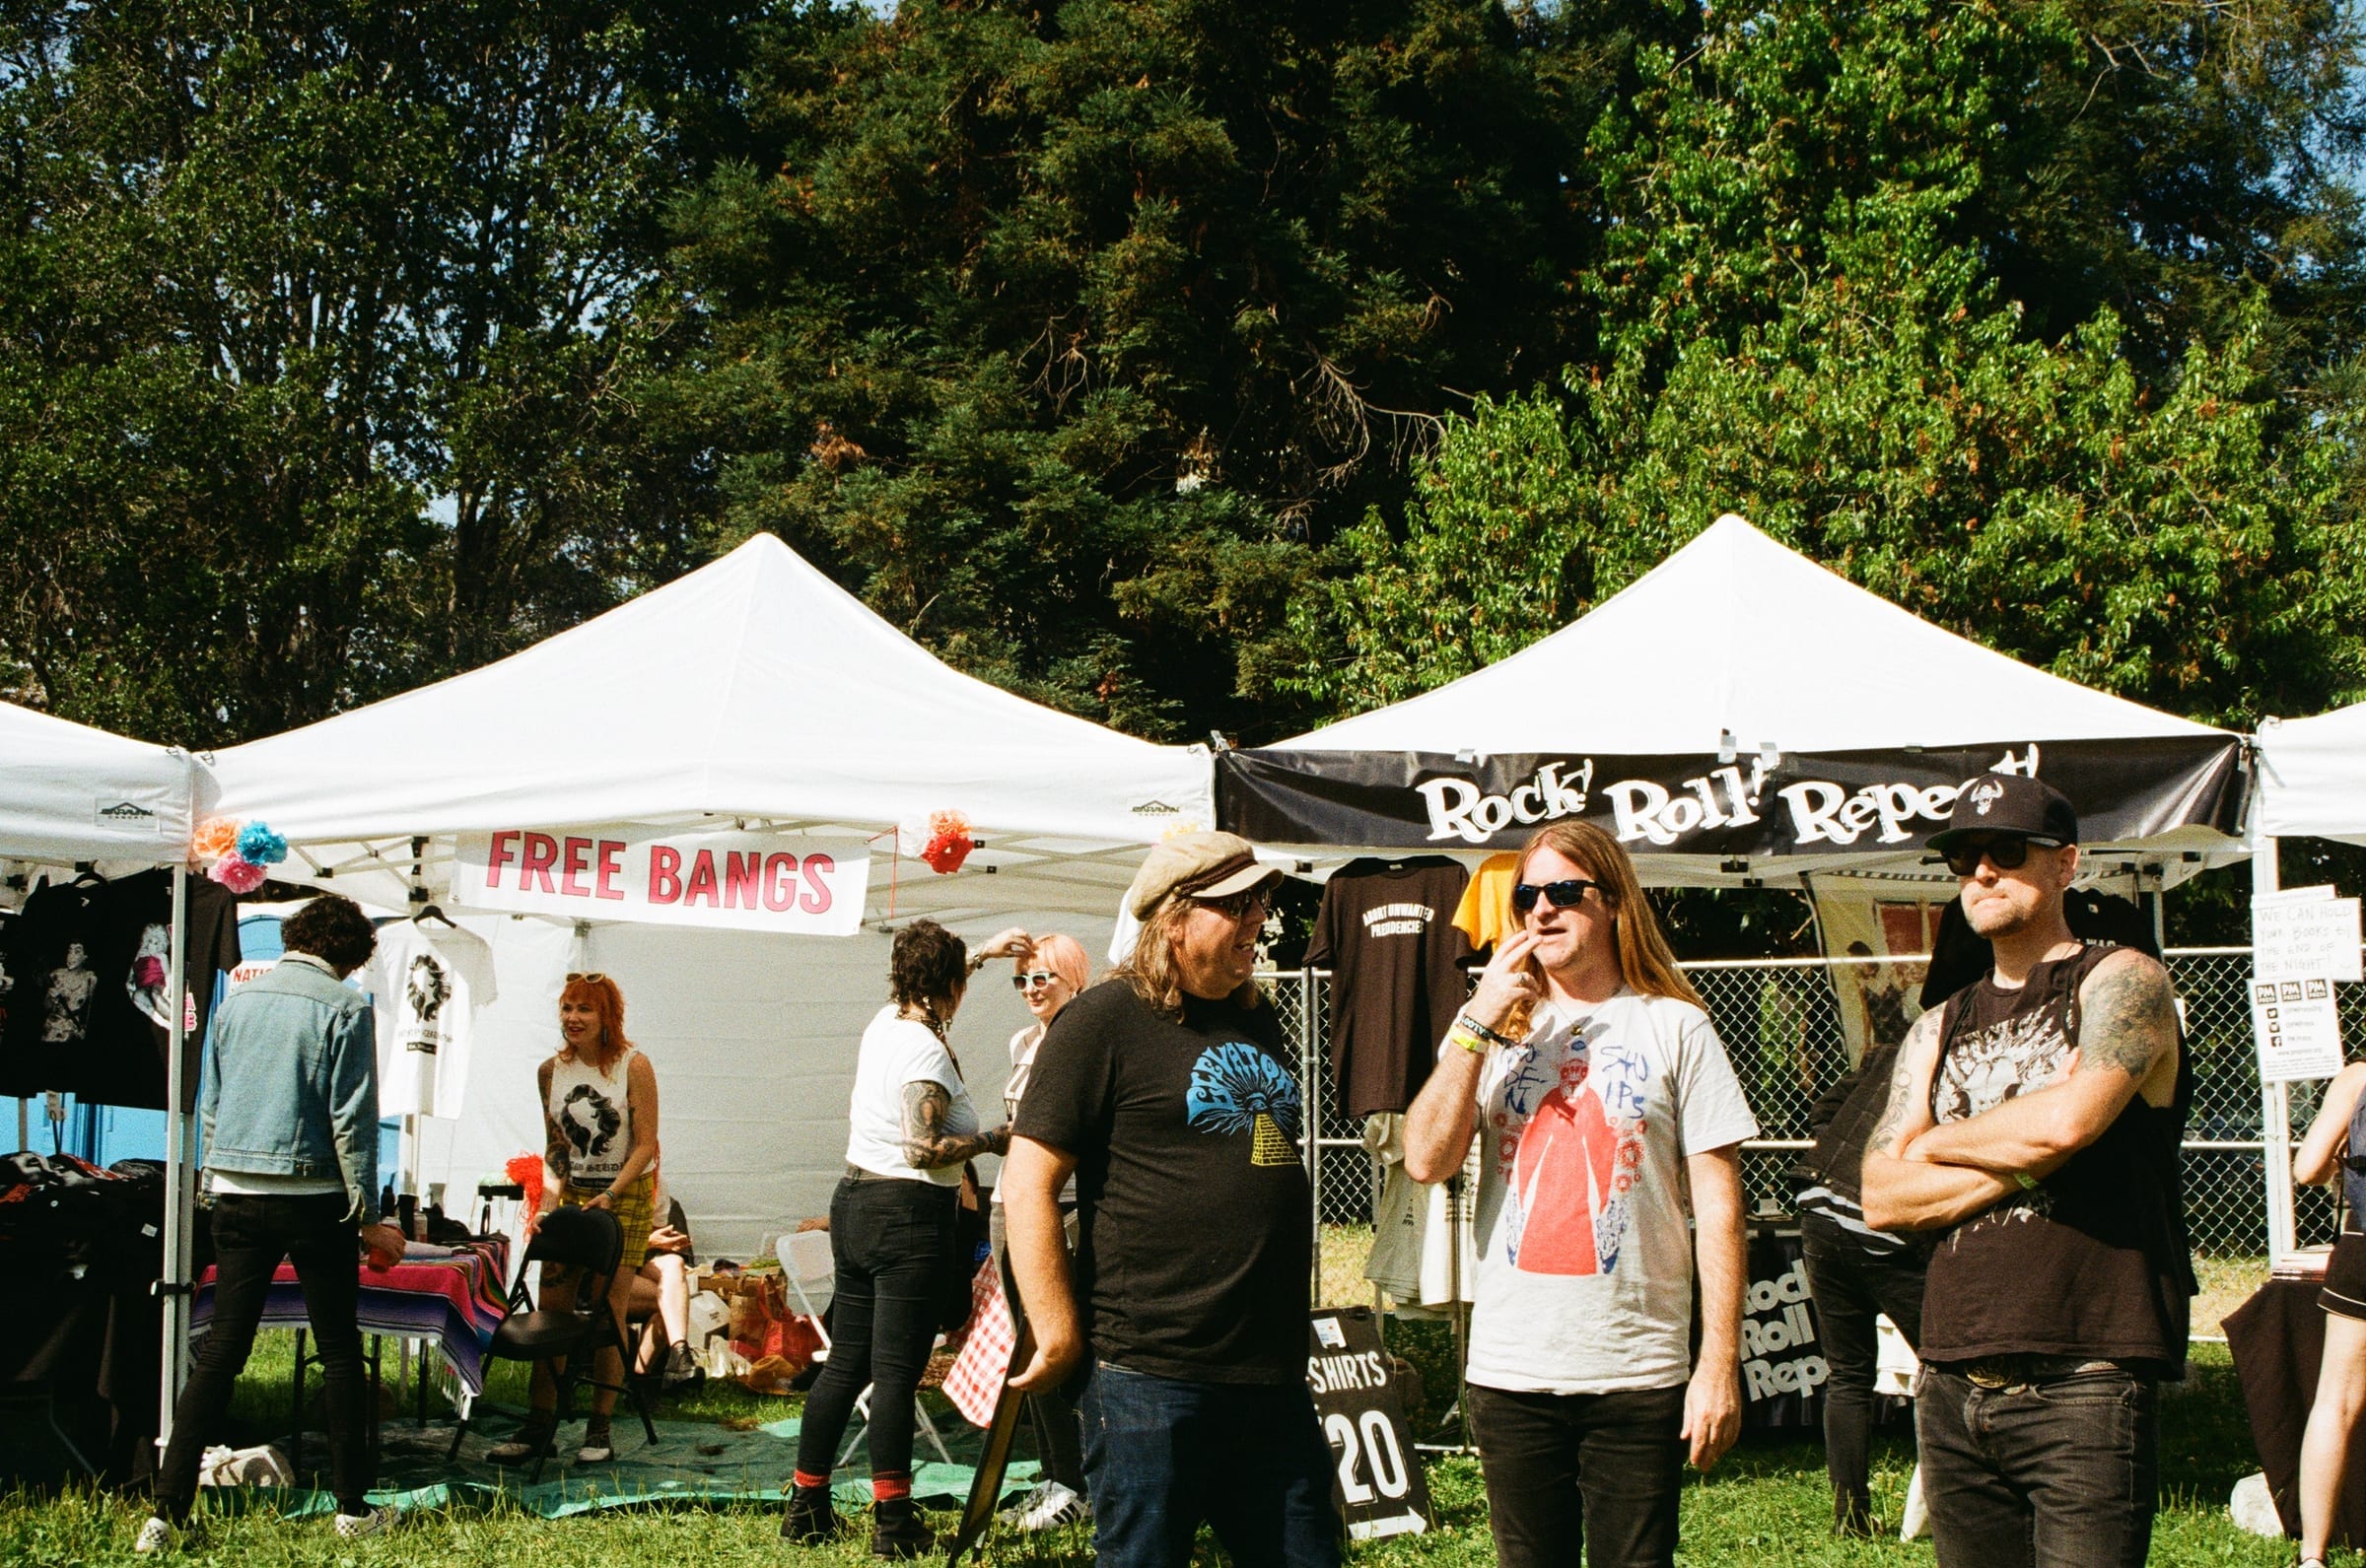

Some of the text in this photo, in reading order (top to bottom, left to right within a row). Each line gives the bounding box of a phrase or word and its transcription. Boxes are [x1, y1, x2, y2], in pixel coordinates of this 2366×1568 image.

[1417, 759, 1593, 844] Rock!
[1602, 758, 1765, 846] Roll!
[486, 830, 835, 915] FREE BANGS
[1362, 903, 1434, 926] ABORT UNWANTED
[2259, 905, 2352, 921] WE CAN HOLD
[1740, 1302, 1816, 1362] Roll
